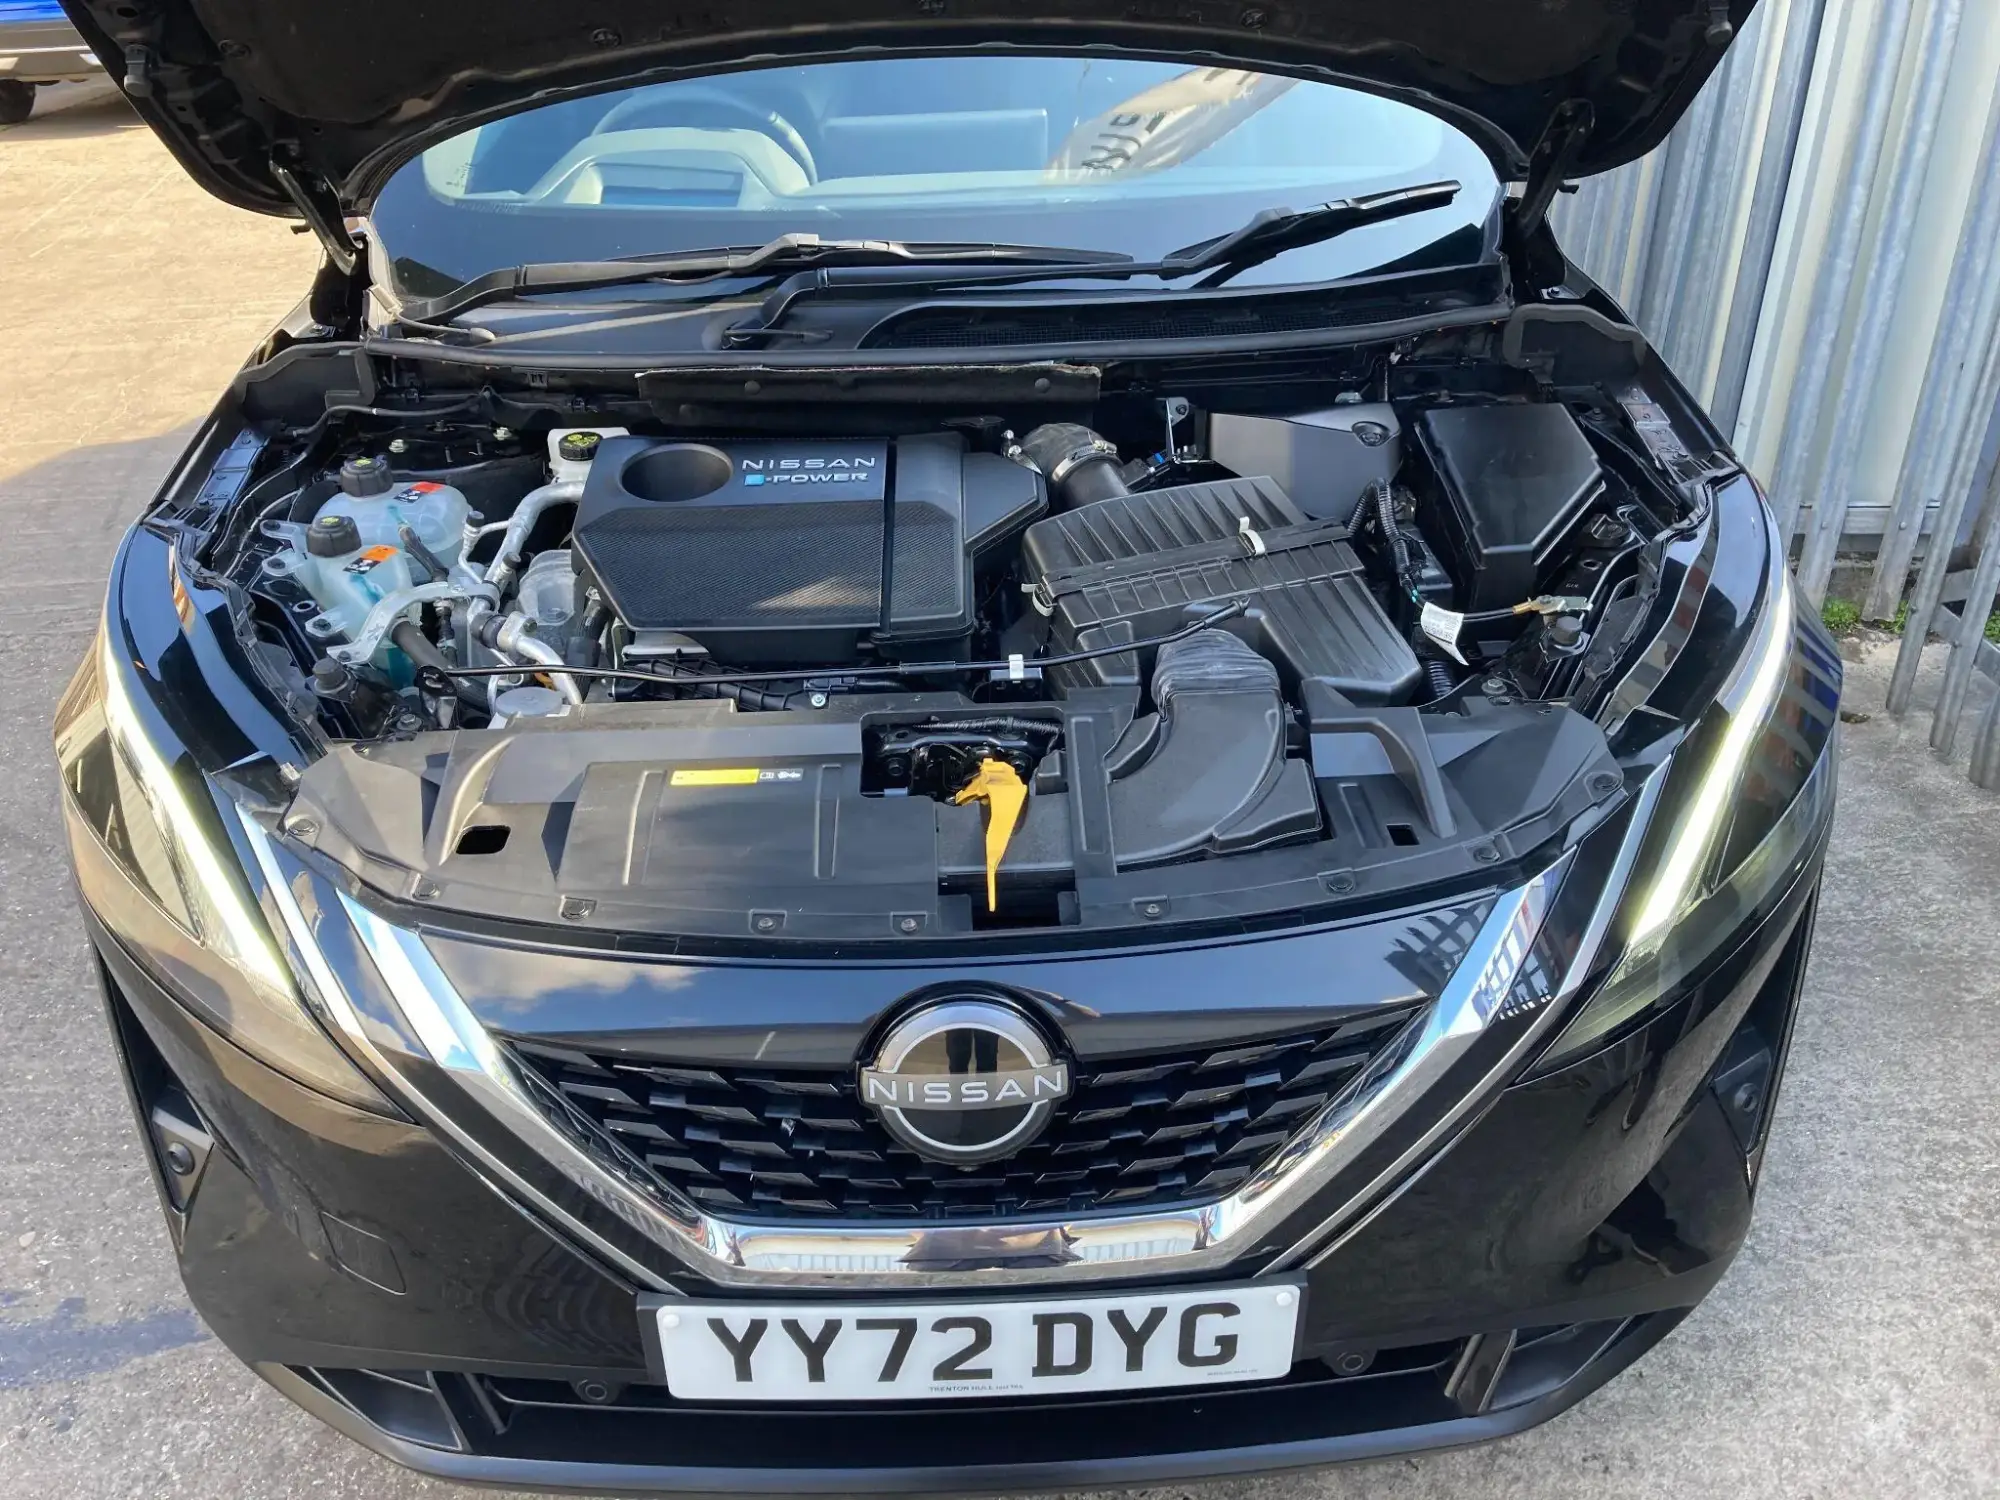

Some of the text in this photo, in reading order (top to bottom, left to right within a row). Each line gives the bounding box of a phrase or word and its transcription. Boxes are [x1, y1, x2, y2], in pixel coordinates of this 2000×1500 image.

[742, 457, 875, 470] NISSAN
[745, 473, 868, 486] -POWER
[868, 1070, 1062, 1102] NISSAN
[706, 1302, 1241, 1382] YY72 DYG
